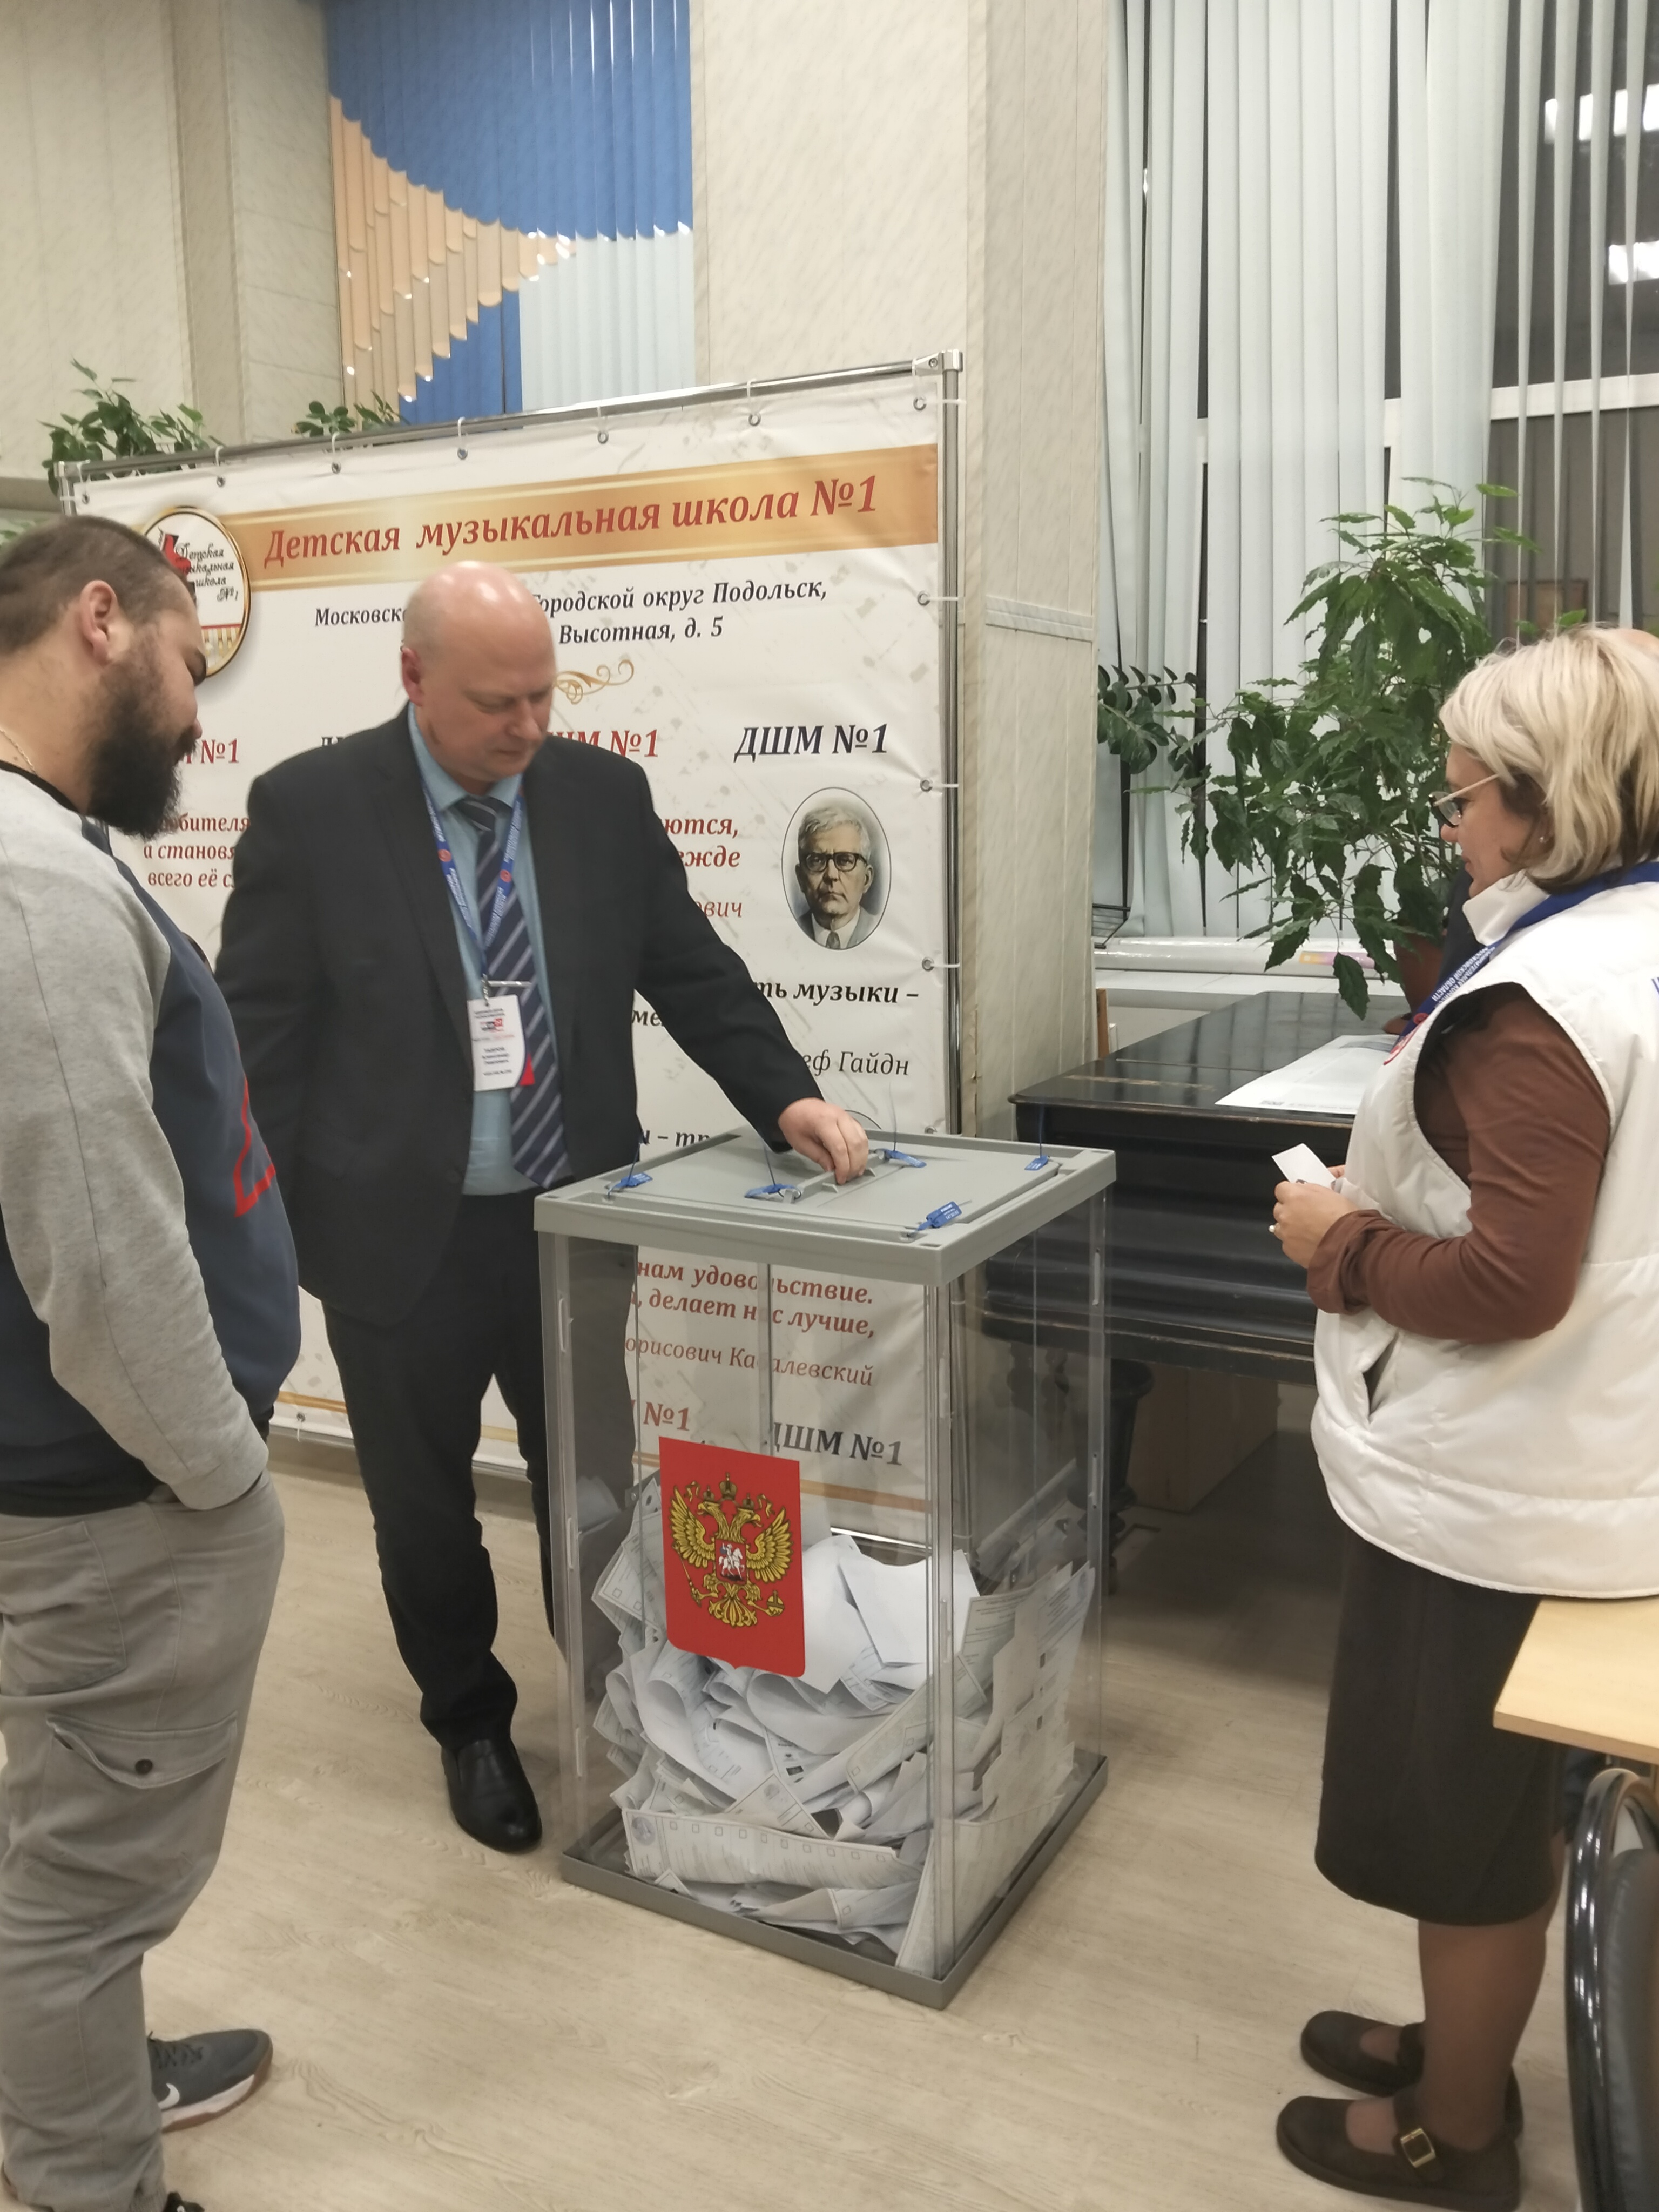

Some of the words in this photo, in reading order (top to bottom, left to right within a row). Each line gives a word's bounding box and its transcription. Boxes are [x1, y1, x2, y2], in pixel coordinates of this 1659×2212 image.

[264, 525, 401, 569] Детская
[416, 502, 660, 555] музыкальная
[672, 490, 799, 528] школа
[810, 474, 878, 517] №1
[315, 607, 406, 627] Московск
[643, 587, 704, 611] округ
[713, 578, 827, 604] Подольск,
[559, 622, 676, 645] Высотная,
[684, 616, 702, 638] д.
[711, 616, 724, 637] 5
[201, 738, 239, 764] №1
[610, 729, 658, 757] №1
[734, 724, 824, 762] ДШМ
[832, 723, 888, 755] №1
[665, 818, 738, 839] ются,
[144, 845, 153, 859] а
[147, 872, 192, 887] всего
[198, 868, 218, 887] её
[793, 983, 899, 1006] музыки
[839, 1050, 909, 1076] Гайдн
[637, 1261, 684, 1281] нам
[649, 1288, 736, 1319] делает
[743, 1305, 783, 1324] нс
[787, 1311, 874, 1339] лучше,
[625, 1337, 722, 1365] орисович
[729, 1347, 873, 1386] Каалевский
[643, 1401, 690, 1432] №1
[849, 1433, 902, 1466] №1
